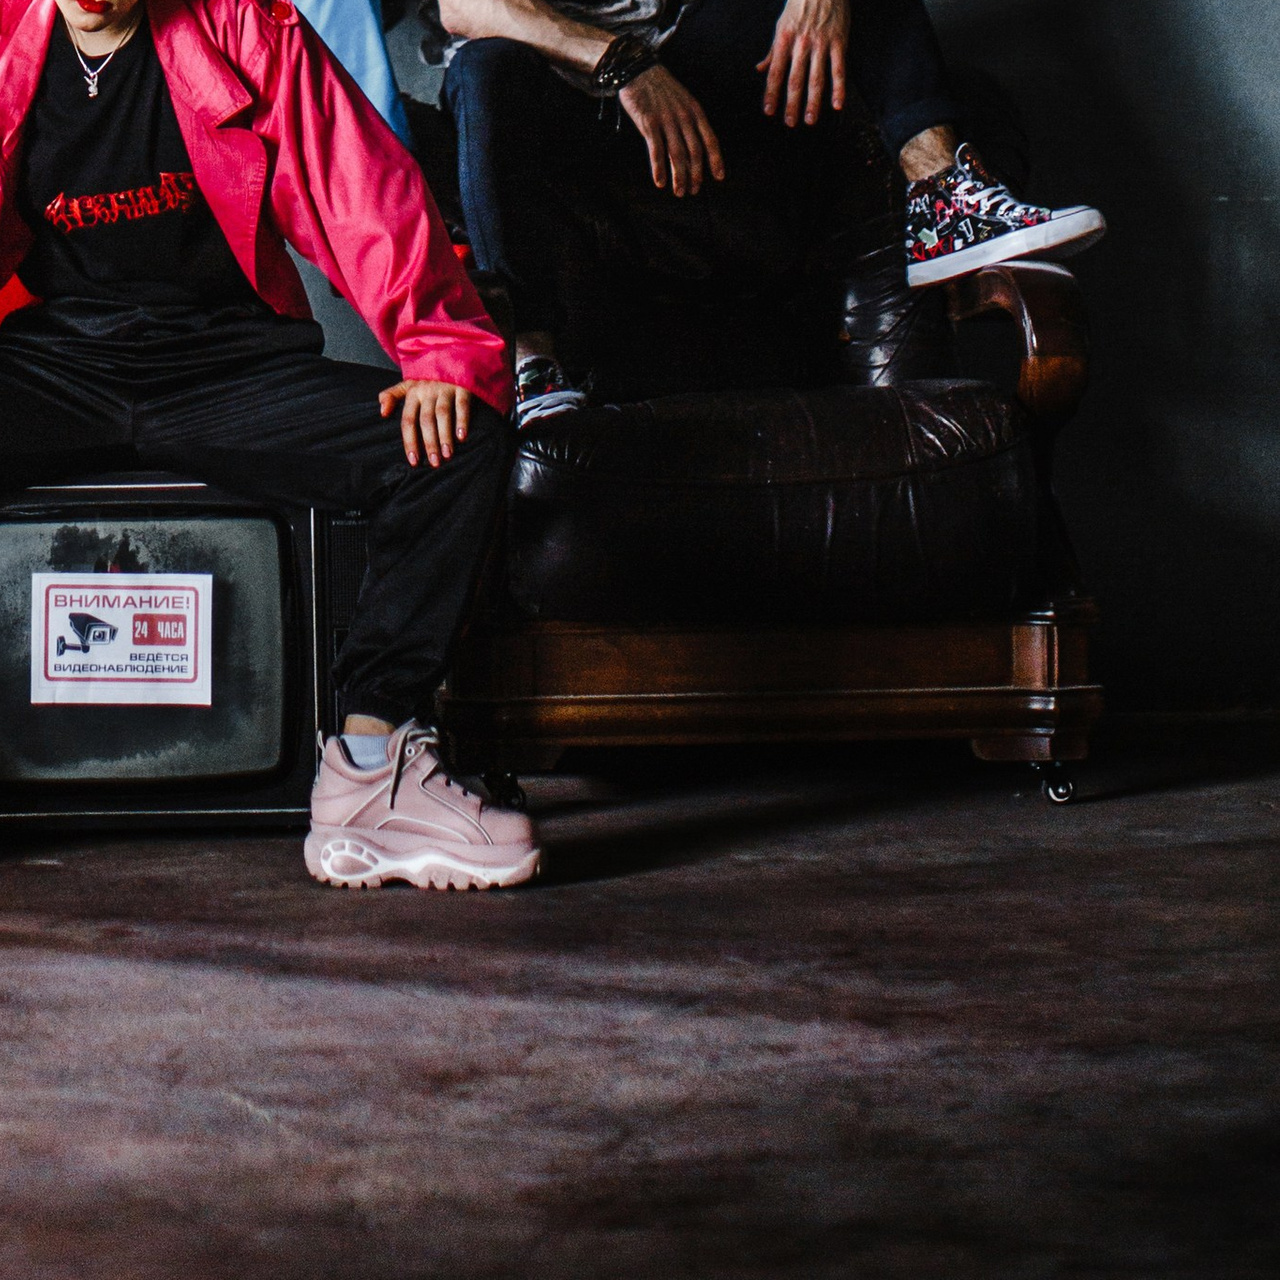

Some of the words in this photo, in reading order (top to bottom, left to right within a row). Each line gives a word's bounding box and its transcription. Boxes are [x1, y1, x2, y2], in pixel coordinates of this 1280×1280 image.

[54, 594, 190, 609] ВНИМАНИЕ!
[134, 621, 148, 639] 24
[157, 621, 185, 639] ЧАСА
[53, 663, 188, 674] ВИДЕОНАБЛЮДЕНИЕ
